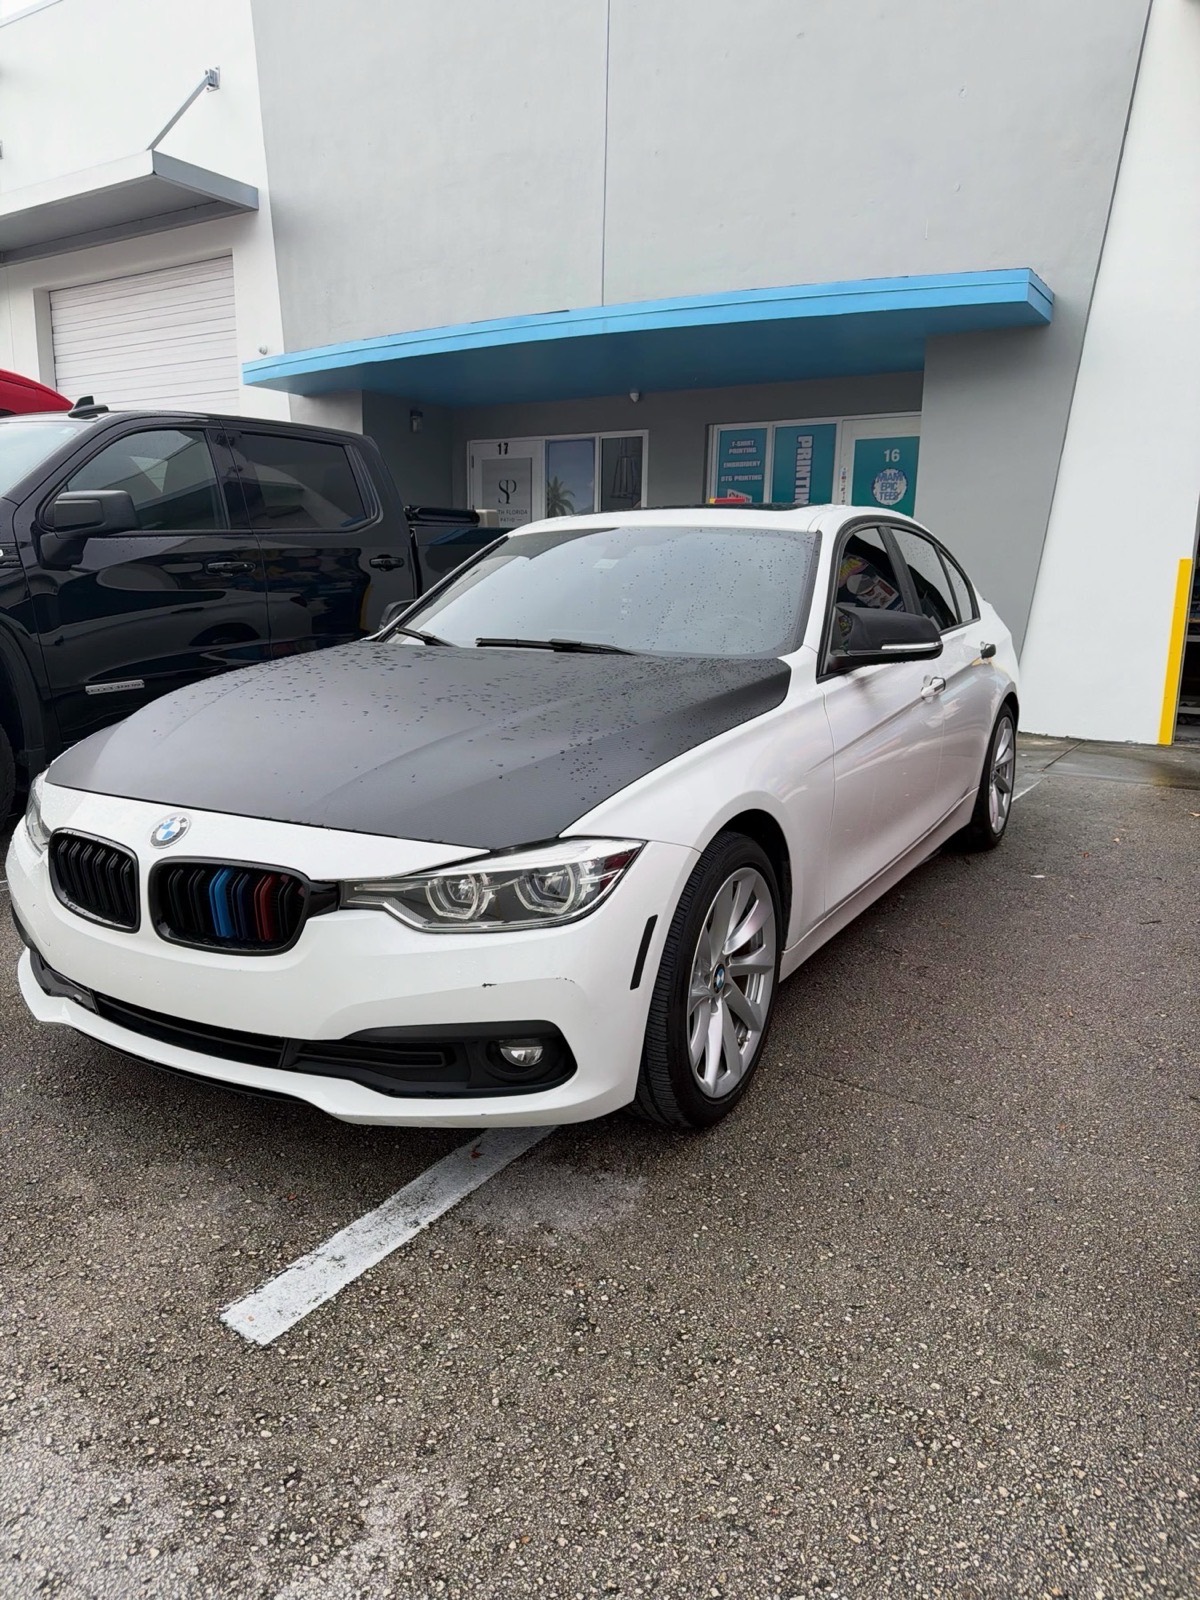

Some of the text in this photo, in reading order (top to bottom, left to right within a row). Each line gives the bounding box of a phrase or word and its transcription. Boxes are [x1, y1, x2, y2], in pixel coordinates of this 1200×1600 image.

[498, 443, 509, 455] 17
[728, 447, 757, 455] PRINTING
[884, 448, 900, 462] 16
[723, 460, 761, 468] EMBROIDERY
[881, 482, 898, 491] EPIC
[879, 491, 900, 501] TEES
